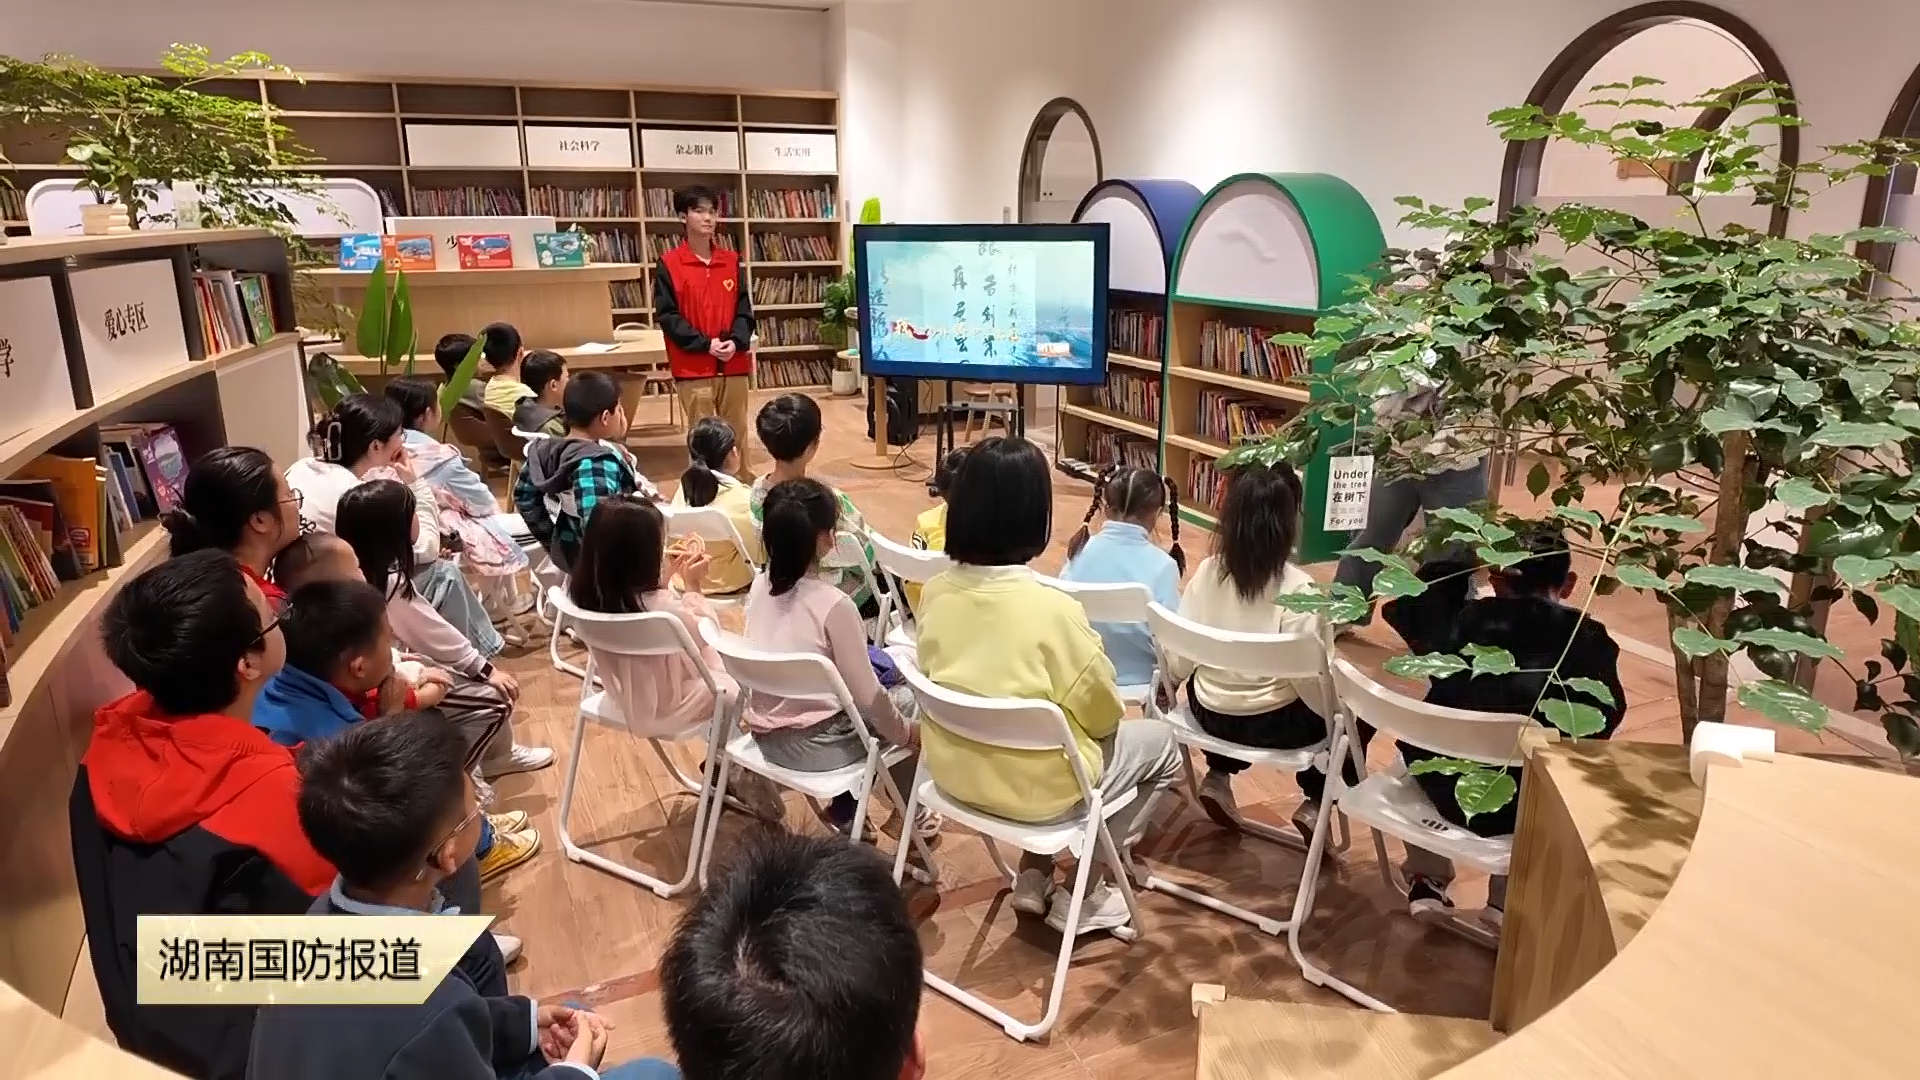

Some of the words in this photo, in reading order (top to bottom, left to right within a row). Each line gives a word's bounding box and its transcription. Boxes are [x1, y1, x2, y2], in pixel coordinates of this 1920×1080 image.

[559, 140, 601, 152] 社会科学
[675, 144, 714, 156] 杂志报刊
[104, 301, 149, 342] 爱心专区
[1333, 469, 1368, 480] Under
[1332, 481, 1347, 489] the
[1350, 481, 1368, 489] tree
[1332, 491, 1366, 503] 在树下
[1330, 517, 1345, 525] For
